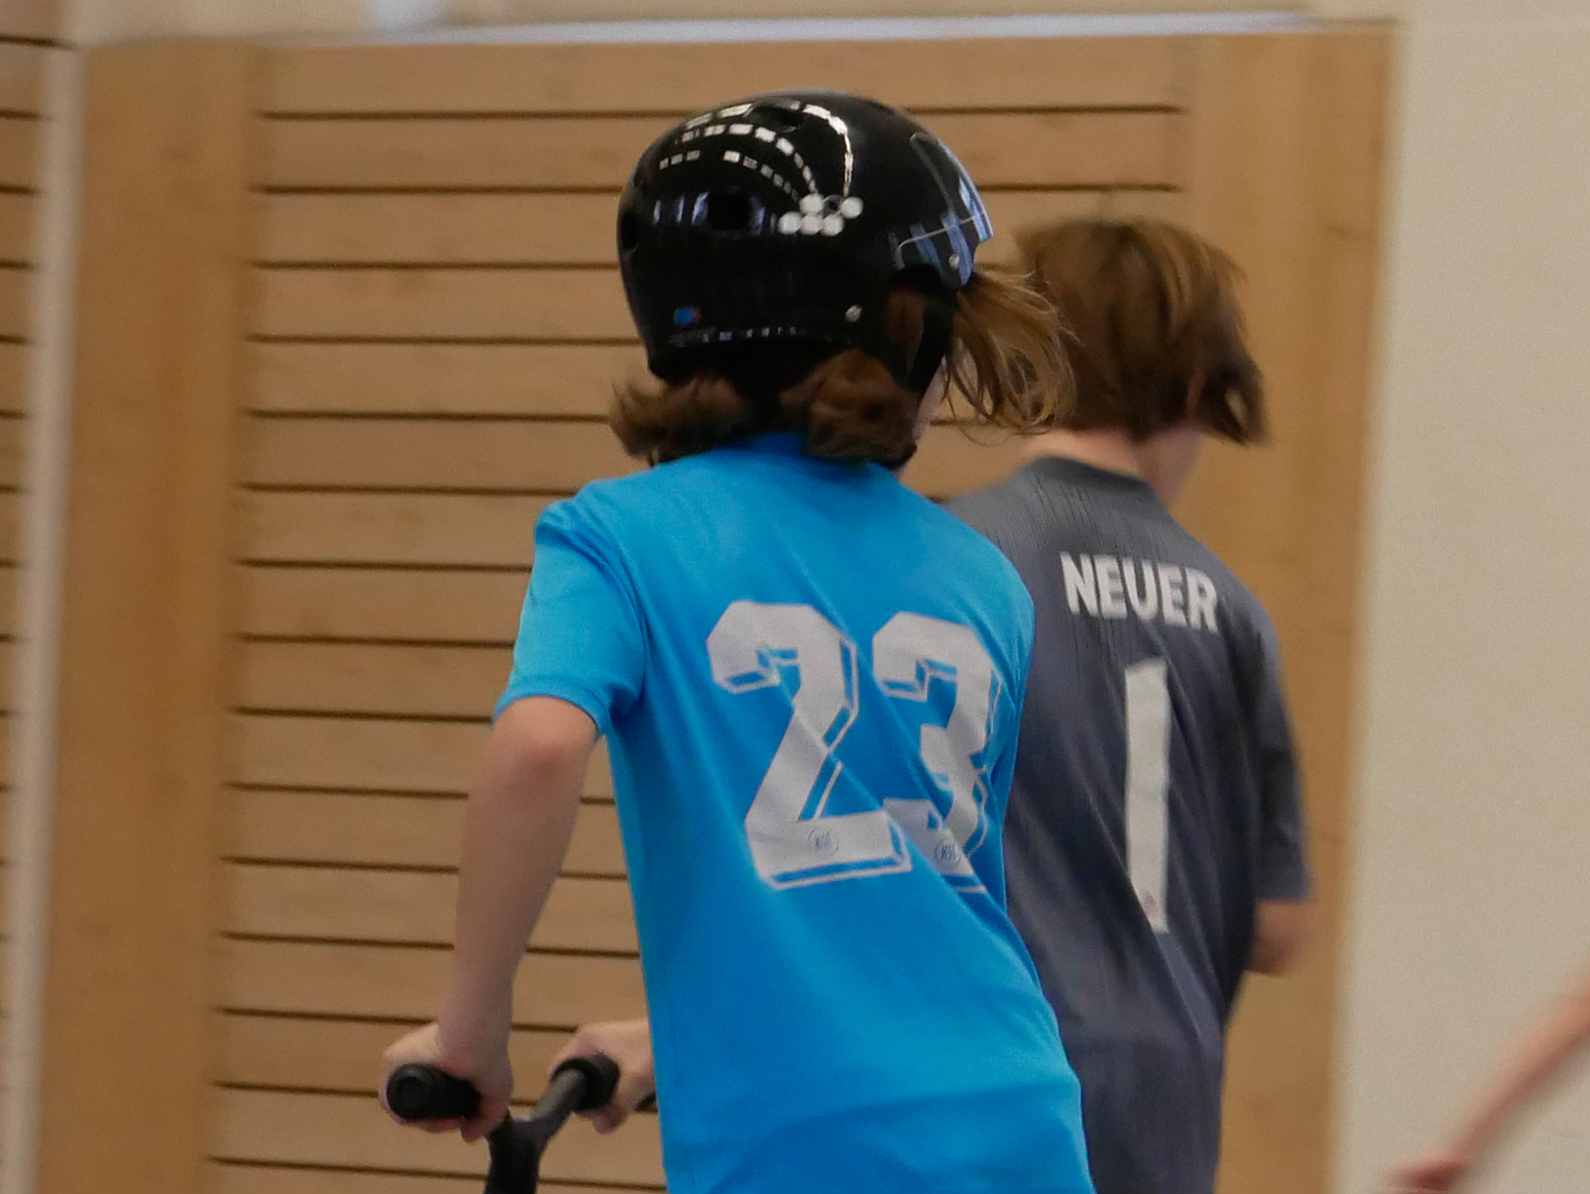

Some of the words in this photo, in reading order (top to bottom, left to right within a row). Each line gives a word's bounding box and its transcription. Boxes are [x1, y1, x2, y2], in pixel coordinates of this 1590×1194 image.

[1059, 551, 1218, 633] NEUER
[706, 599, 1001, 894] 23
[1124, 658, 1171, 934] 1
